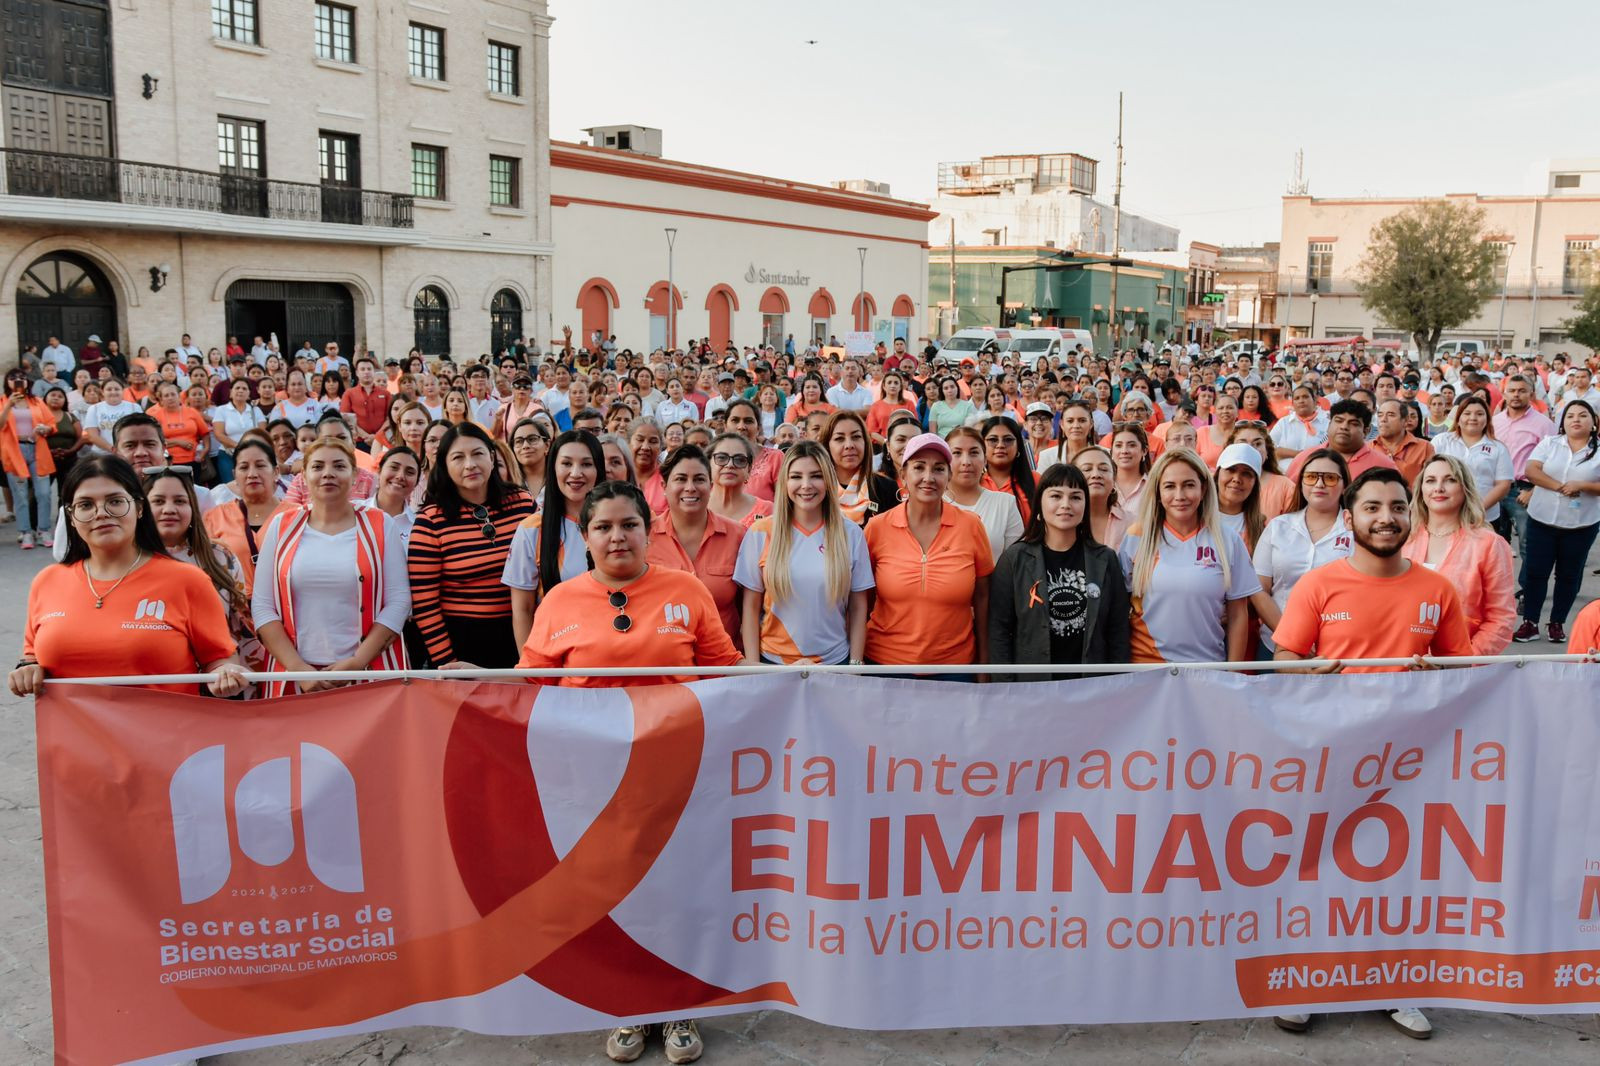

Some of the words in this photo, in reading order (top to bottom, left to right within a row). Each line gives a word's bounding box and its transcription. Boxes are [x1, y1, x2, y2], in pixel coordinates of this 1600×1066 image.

[759, 268, 811, 286] Santander
[731, 738, 836, 797] Día
[866, 737, 1330, 797] Internacional
[1352, 741, 1424, 789] de
[1452, 728, 1506, 782] la
[731, 788, 1507, 900] ELIMINACIÓN
[231, 888, 265, 897] 2024
[281, 884, 314, 895] 2027
[159, 911, 341, 938] Secretaría
[355, 904, 393, 925] de
[732, 902, 790, 943] de
[808, 909, 846, 955] la
[864, 906, 1088, 956] Violencia
[1105, 907, 1259, 950] contra
[1276, 897, 1311, 939] la
[1328, 895, 1506, 938] MUJER
[160, 941, 302, 966] Bienestar
[308, 927, 395, 954] Social
[159, 965, 227, 985] GOBIERNO
[229, 961, 297, 977] MUNICIPAL
[298, 959, 315, 972] DE
[317, 951, 398, 970] MATAMOROS
[1267, 960, 1525, 990] #NoALaViolencia
